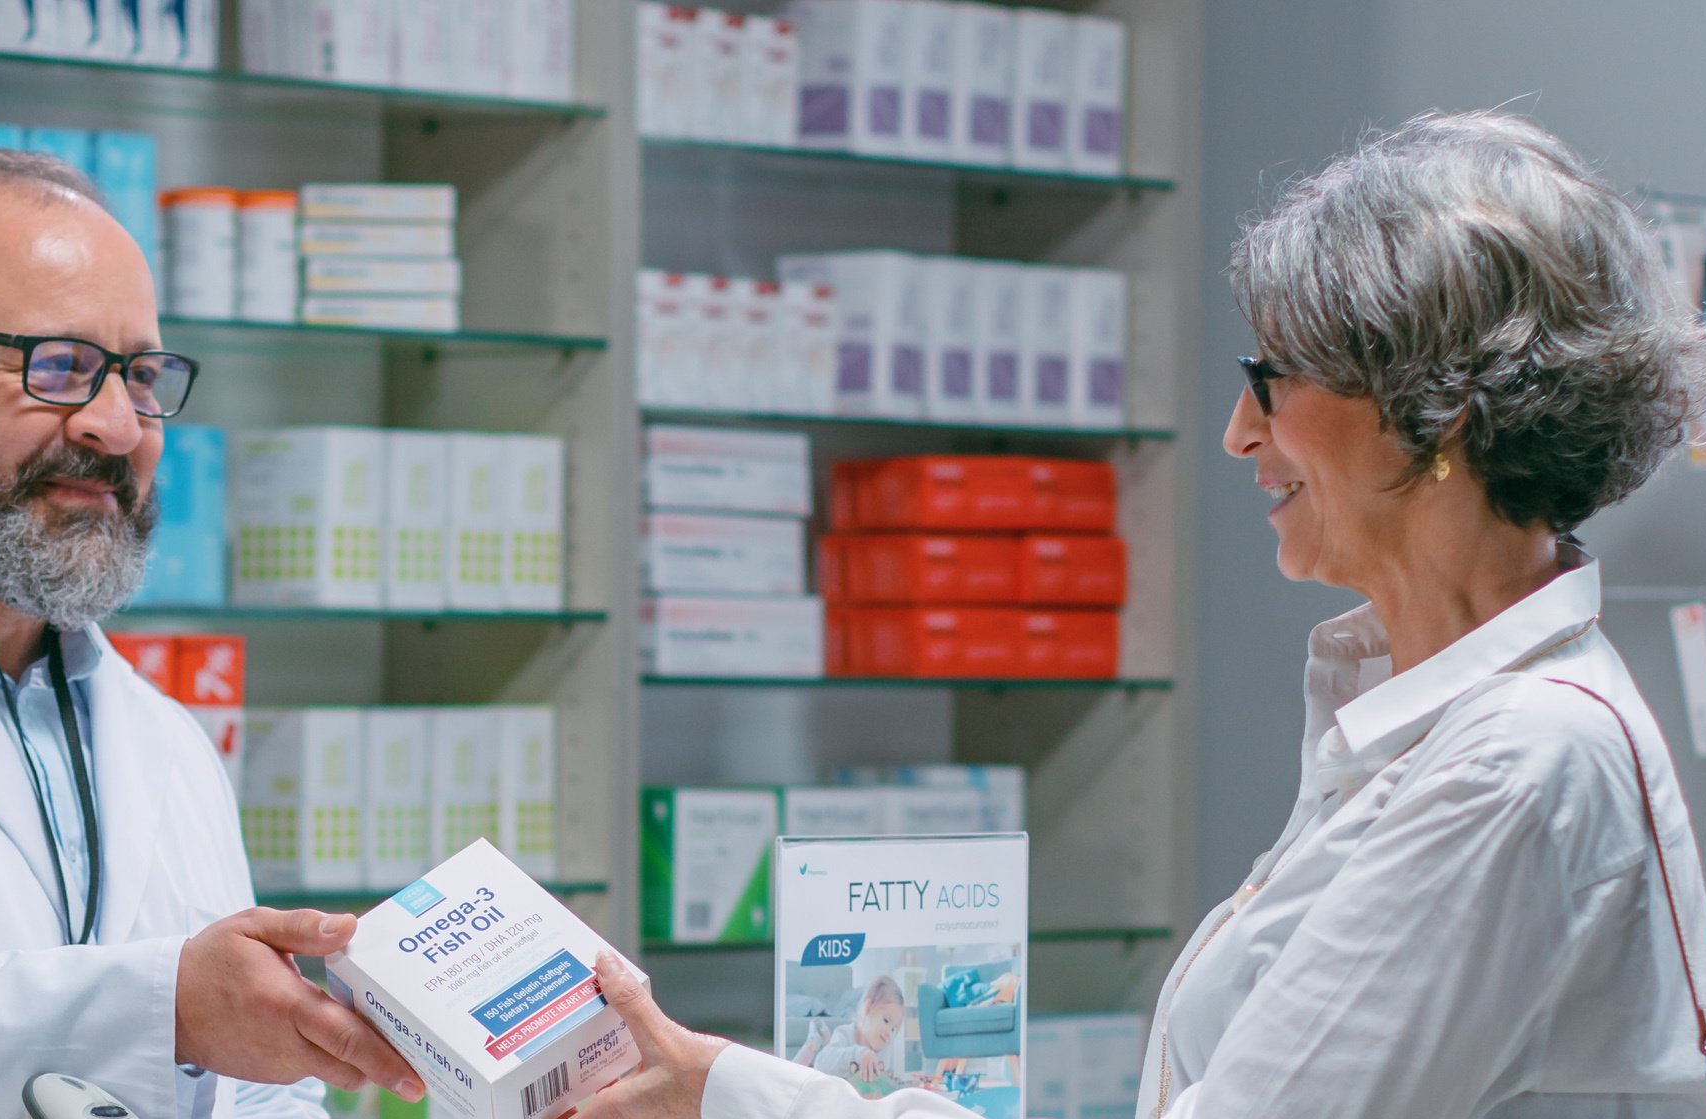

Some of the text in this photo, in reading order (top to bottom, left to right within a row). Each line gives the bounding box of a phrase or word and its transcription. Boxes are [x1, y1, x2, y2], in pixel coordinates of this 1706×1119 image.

[398, 887, 495, 953] Omega-3
[848, 880, 1000, 912] FATTY ACIDS
[935, 920, 999, 931] polyunsaturated
[422, 905, 505, 964] Fish Oil
[424, 975, 445, 992] EPA
[443, 963, 463, 980] 180
[462, 953, 481, 966] mg
[484, 934, 508, 952] DHA
[505, 922, 524, 938] 120
[523, 912, 543, 927] mg
[447, 930, 539, 991] 1000 mg fish oil per softgel
[818, 939, 851, 959] KIDS
[484, 960, 572, 1020] 150 Fish Gelatin Softgels
[496, 979, 600, 1053] HELPS PROMOTE HEART HEA
[499, 972, 572, 1023] Dietary Supplement
[365, 991, 472, 1090] Omega-3 Fish Oil
[578, 1020, 627, 1058] Omega-3
[579, 1036, 618, 1069] Fish Oil
